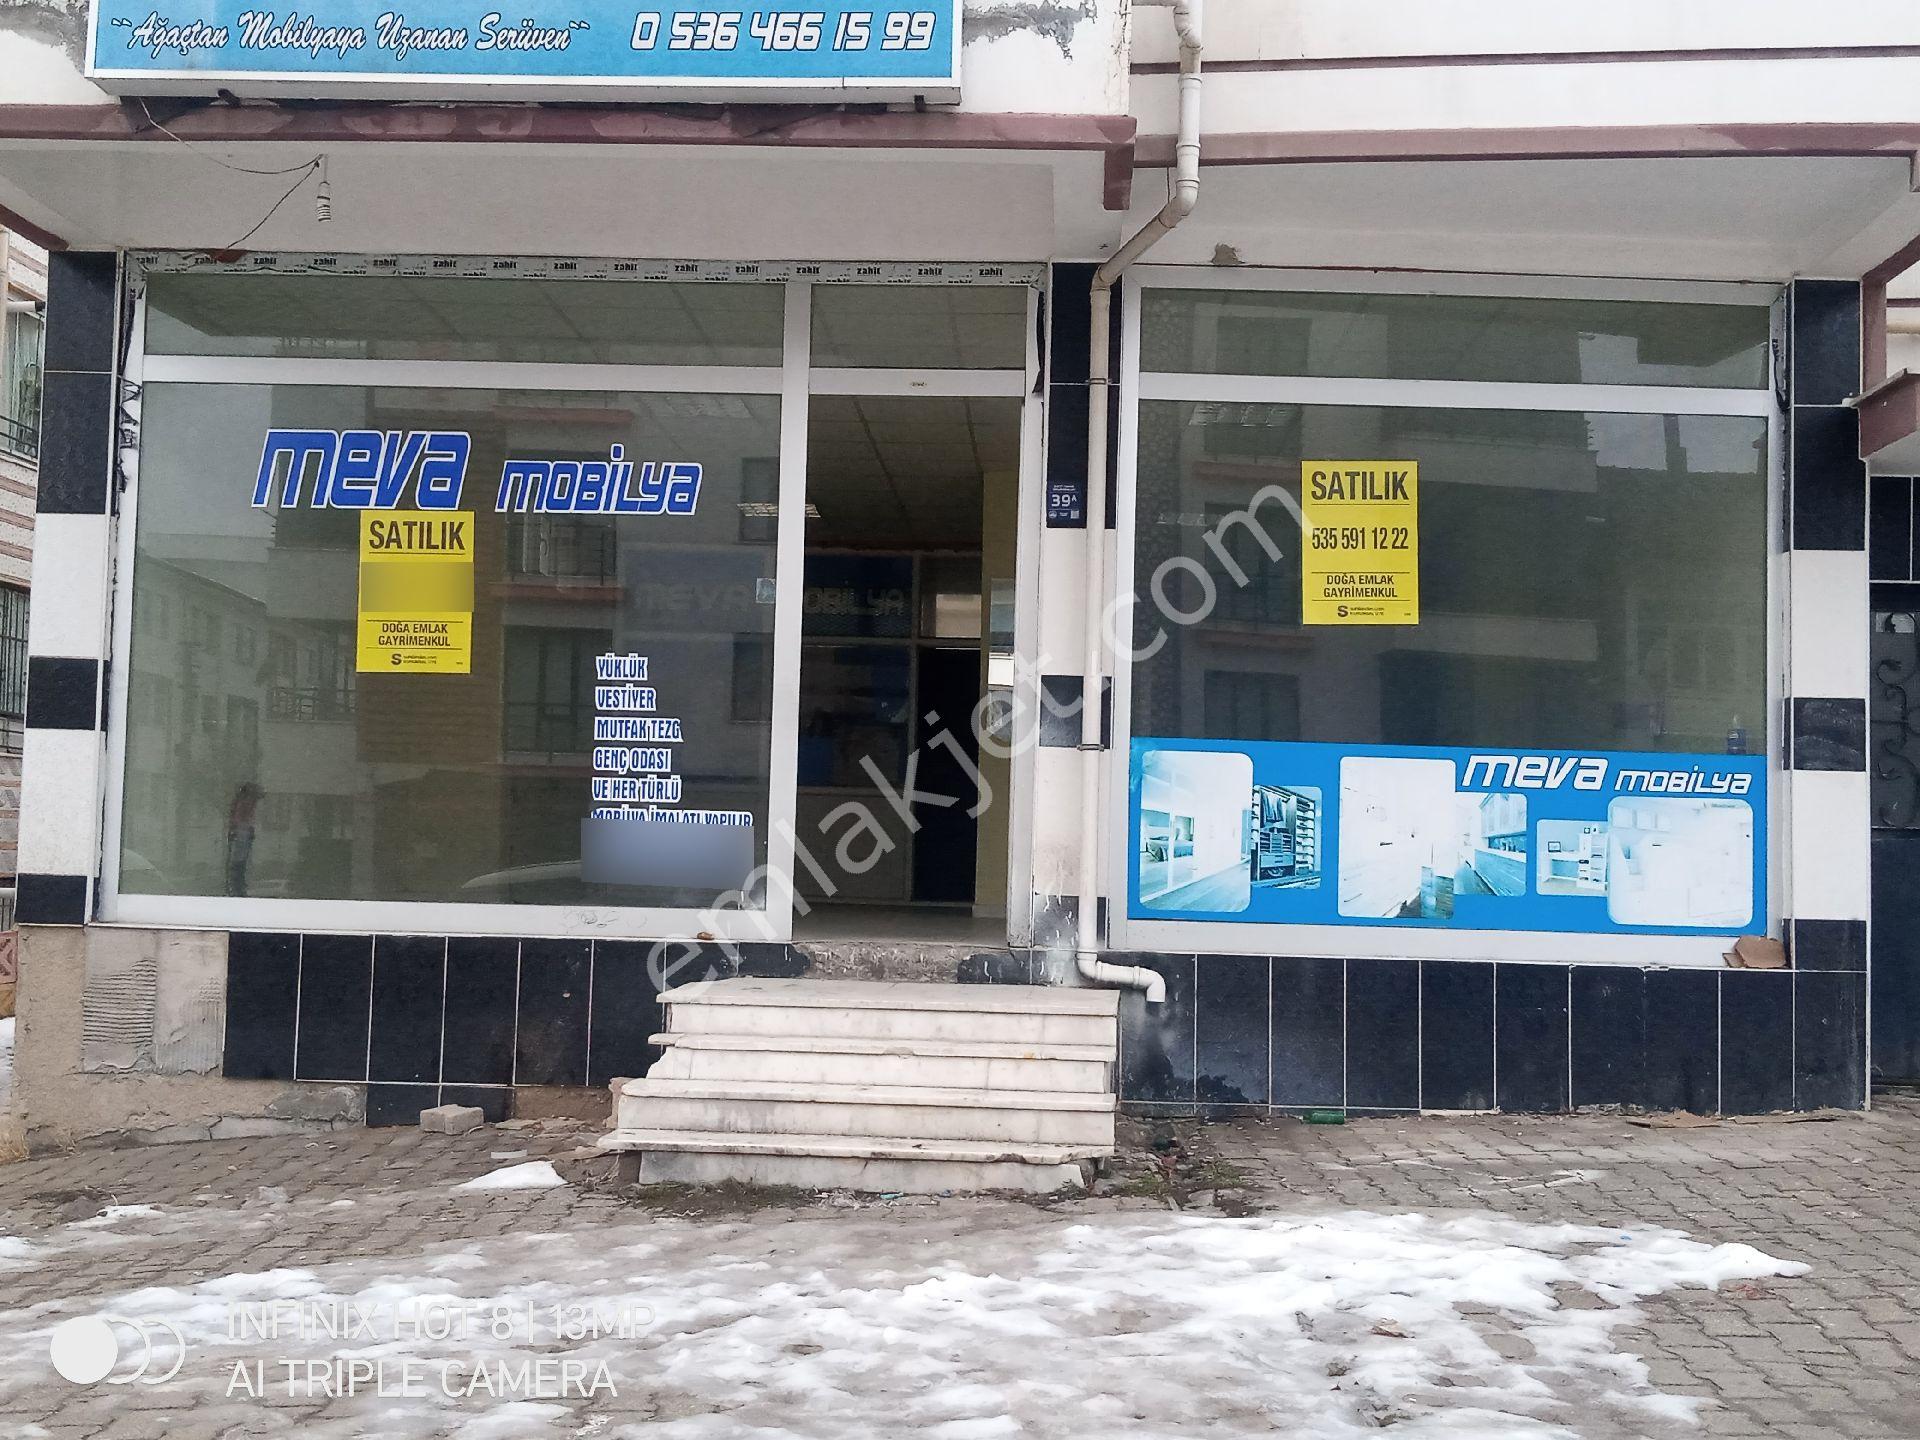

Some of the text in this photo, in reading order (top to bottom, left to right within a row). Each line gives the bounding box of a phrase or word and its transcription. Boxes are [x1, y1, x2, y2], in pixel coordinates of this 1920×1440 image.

[237, 11, 366, 59] Mobilyaya
[376, 12, 468, 60] Uzanan
[630, 12, 661, 51] 0
[668, 12, 742, 51] 536
[749, 12, 825, 51] 466
[833, 12, 873, 51] 15
[880, 12, 936, 51] 99
[1311, 470, 1410, 501] SATILIK
[369, 519, 466, 550] SATILIK
[1312, 527, 1409, 549] 535 591 12 22
[1326, 573, 1395, 585] DOĞA EMLAK
[1323, 586, 1398, 598] GAYRİMENKUL
[382, 621, 449, 634] DOĞA EMLAK
[378, 634, 451, 647] GAYRİMENKUL
[596, 653, 648, 680] YÜKLÜK
[595, 684, 656, 710] VESTİYER
[595, 718, 648, 740] MUTFAK
[594, 748, 671, 773] GENÇ ODASI
[592, 776, 681, 801] VE HER TÜRLÜ
